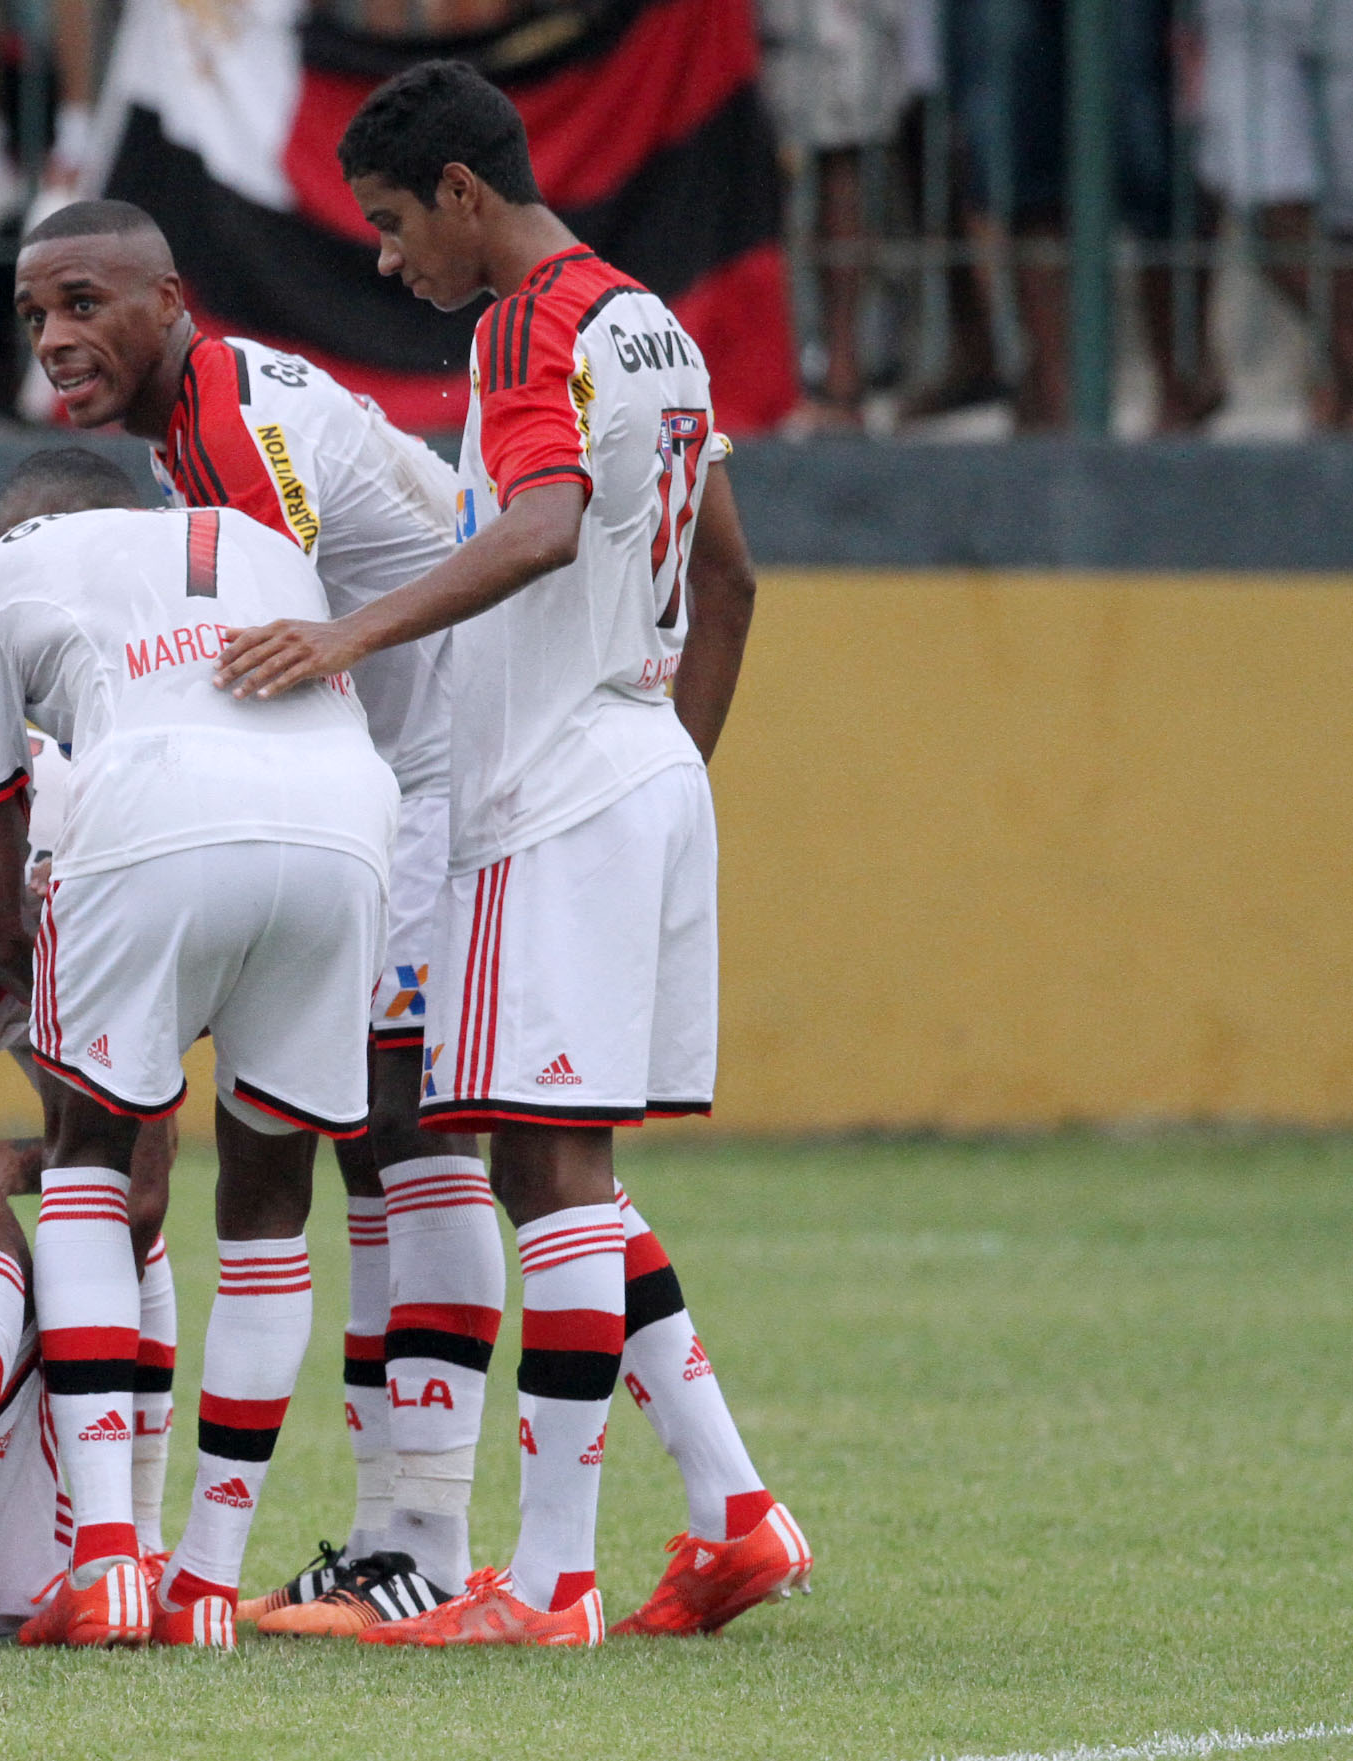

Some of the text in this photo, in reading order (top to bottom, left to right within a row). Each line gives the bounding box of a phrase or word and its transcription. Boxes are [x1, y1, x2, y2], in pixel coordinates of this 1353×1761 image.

[648, 408, 708, 628] 17
[126, 623, 230, 680] MARCE
[387, 1378, 454, 1410] LA
[204, 1489, 254, 1509] adidas
